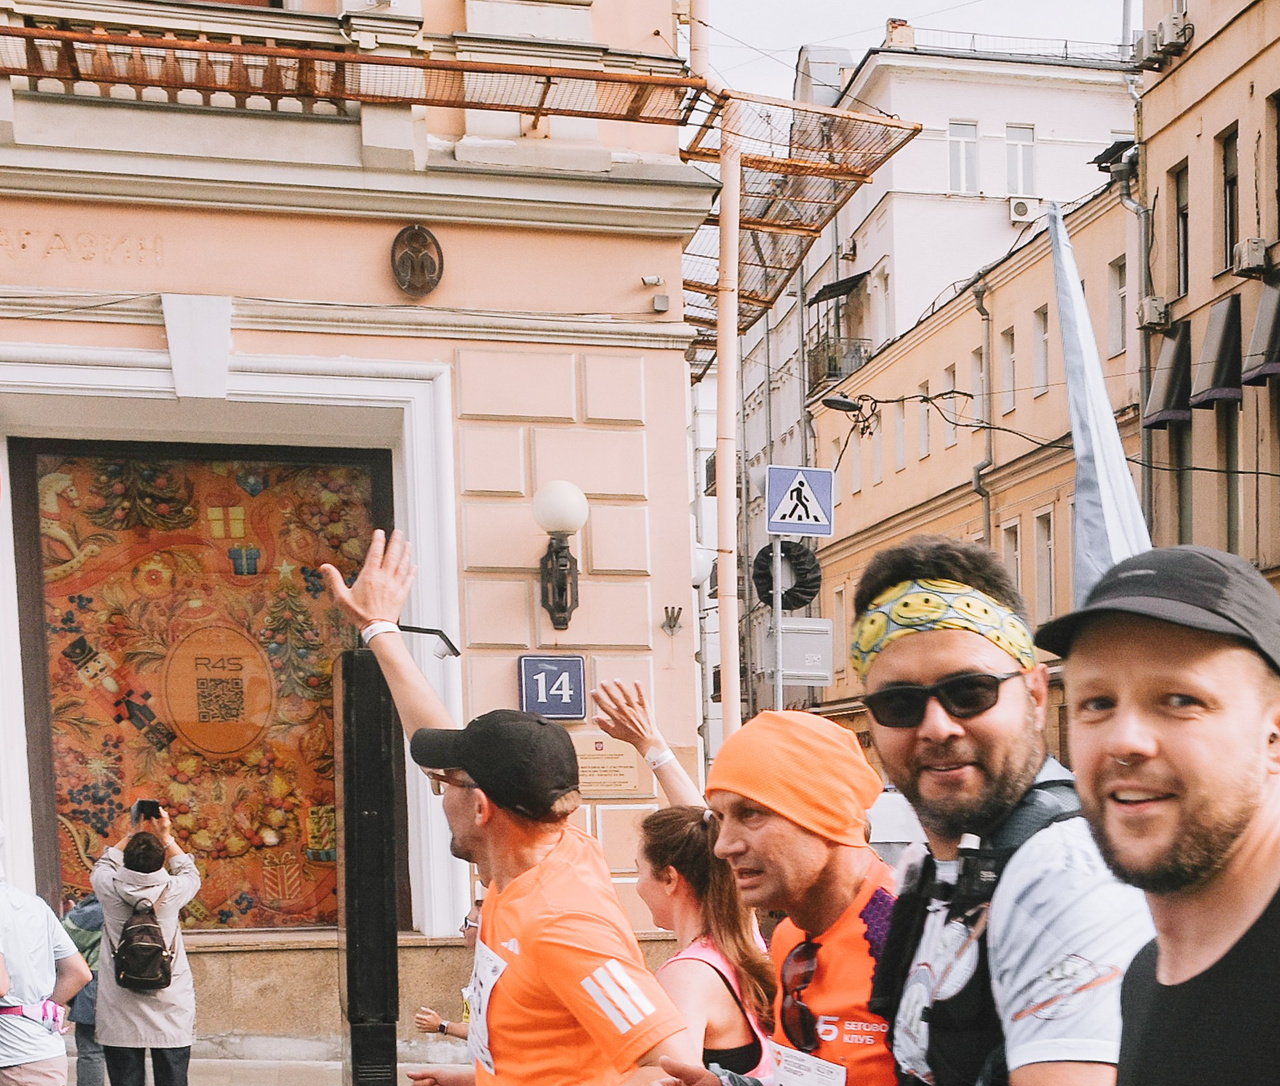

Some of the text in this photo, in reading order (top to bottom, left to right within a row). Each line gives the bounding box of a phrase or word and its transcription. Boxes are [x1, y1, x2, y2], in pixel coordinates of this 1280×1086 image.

[194, 657, 244, 671] R4S
[533, 671, 574, 703] 14
[843, 1020, 889, 1034] БЕГОВО
[842, 1034, 875, 1045] КЛУБ
